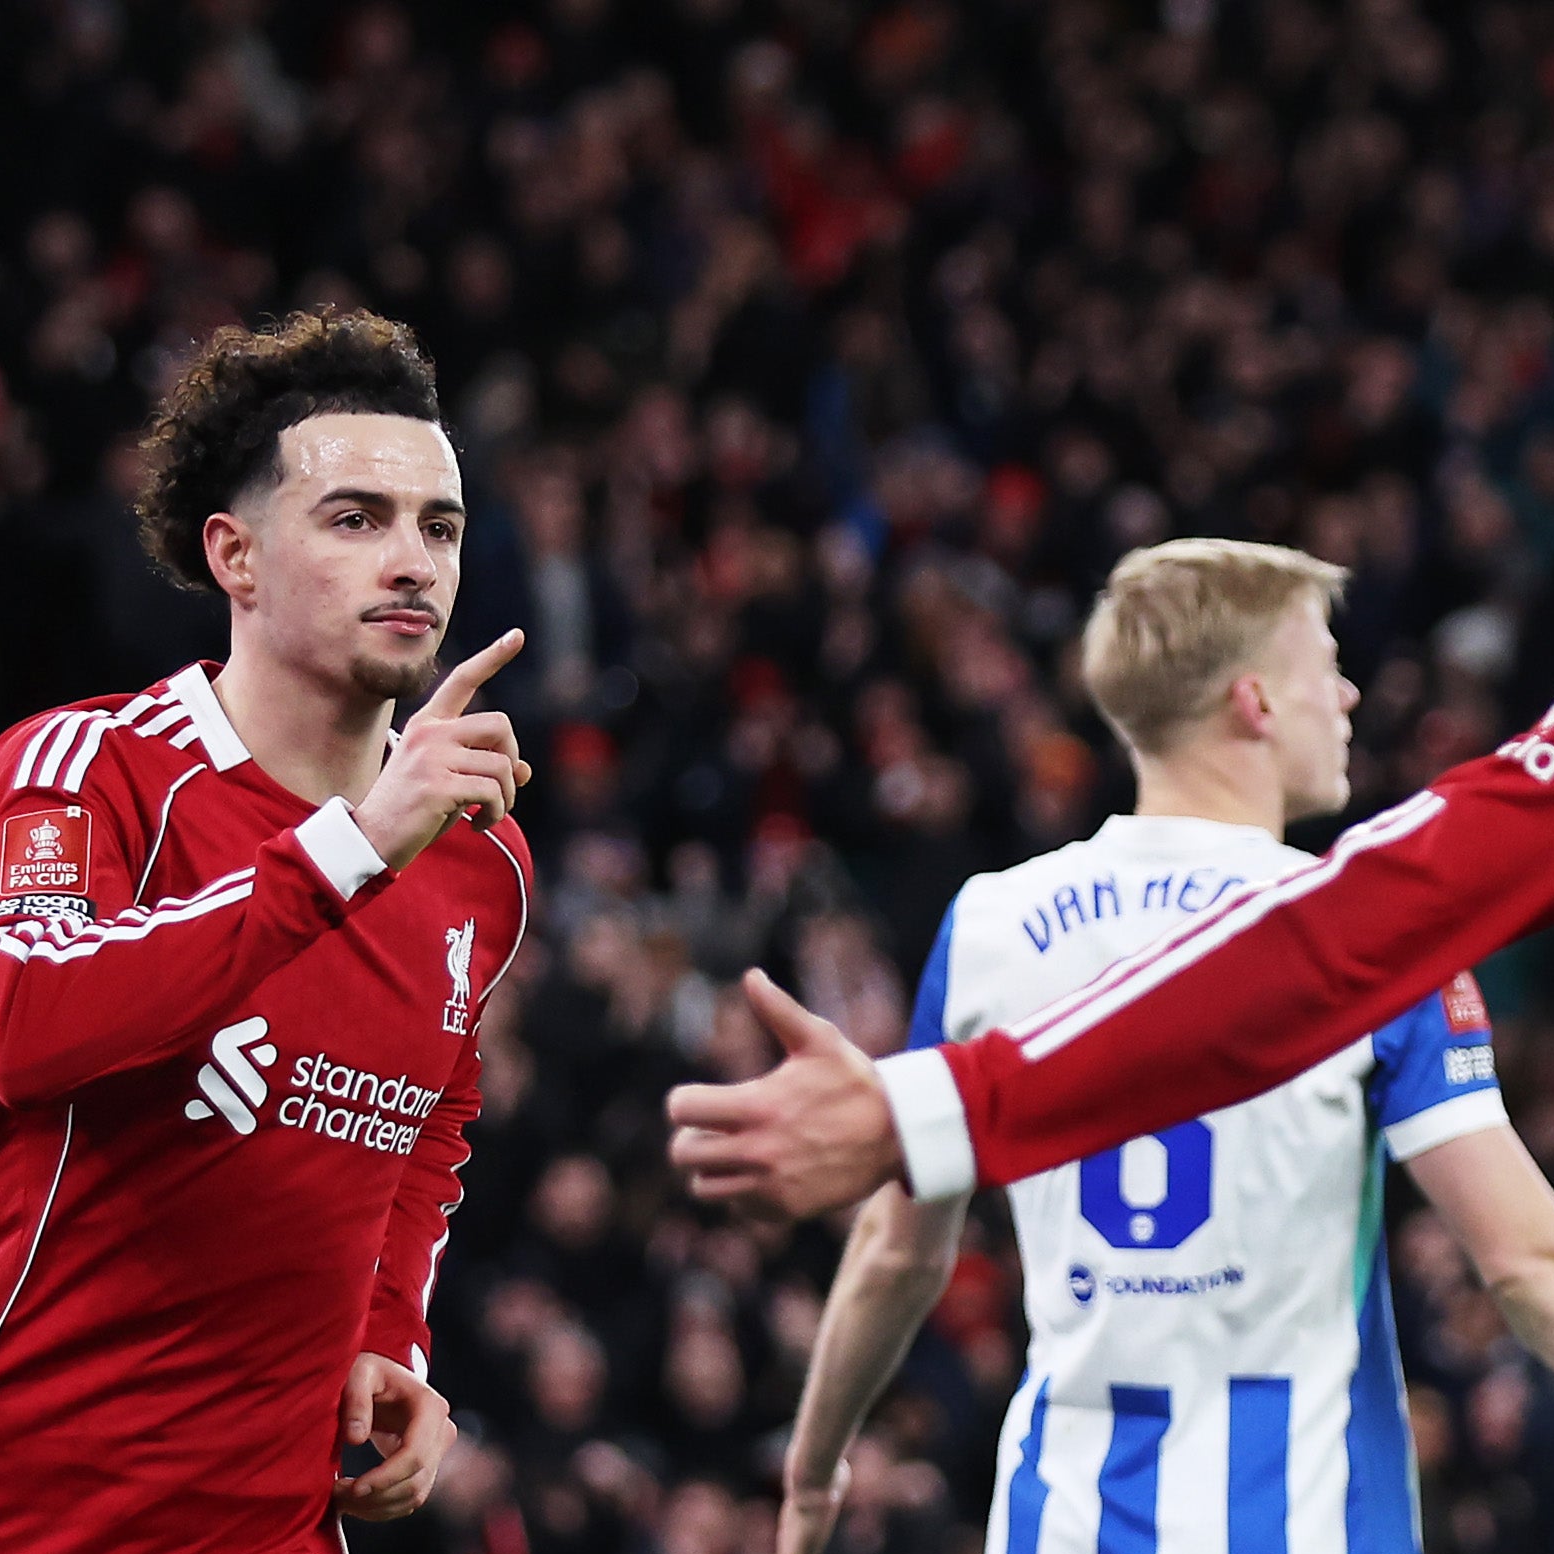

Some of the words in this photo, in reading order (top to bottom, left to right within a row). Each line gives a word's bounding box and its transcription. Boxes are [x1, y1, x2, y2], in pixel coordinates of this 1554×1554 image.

[9, 875, 33, 888] FA
[36, 873, 78, 886] CUP
[10, 862, 78, 876] Emirates
[25, 895, 88, 913] room
[1023, 872, 1120, 952] VAN
[291, 1053, 444, 1119] standard
[279, 1092, 424, 1155] chartered
